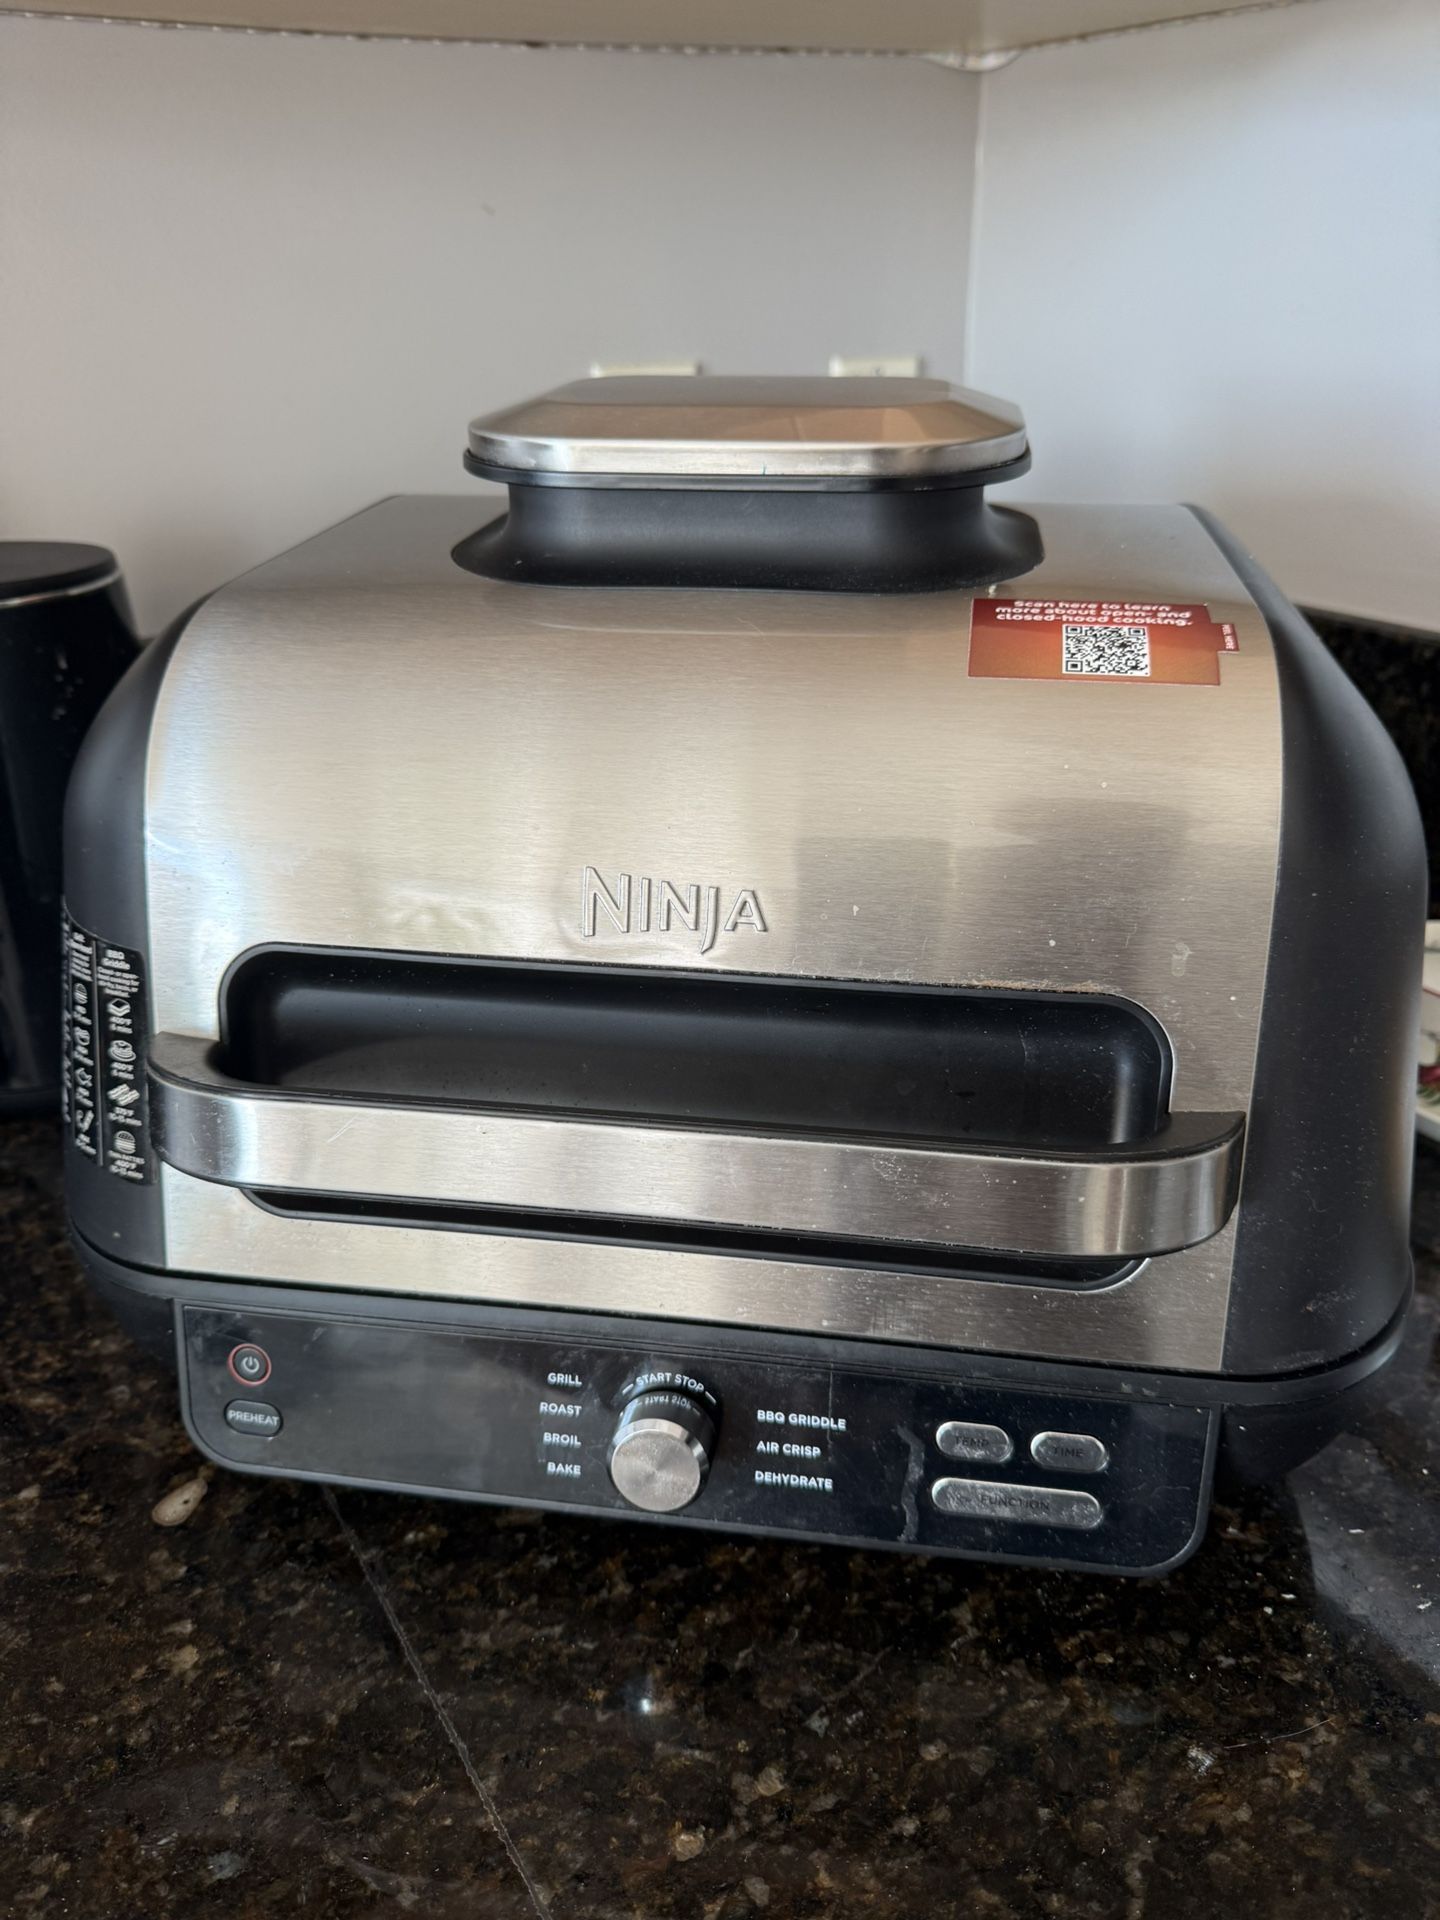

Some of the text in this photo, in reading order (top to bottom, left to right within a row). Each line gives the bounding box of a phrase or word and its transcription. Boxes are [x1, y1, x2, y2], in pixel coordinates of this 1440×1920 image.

[995, 606, 1192, 619] more about open- and
[1014, 600, 1171, 612] Scan here to learn
[996, 612, 1193, 627] closed-hood cooking.
[581, 866, 768, 954] NINJA
[547, 1372, 582, 1386] GRILL
[635, 1372, 705, 1393] START STOP
[539, 1402, 582, 1416] ROAST
[228, 1409, 280, 1427] PREHEAT
[757, 1409, 847, 1431] BBQ GRIDDLE
[543, 1432, 582, 1446] BROIL
[954, 1435, 990, 1448] TEMP
[756, 1440, 822, 1459] AIR CRISP
[1052, 1445, 1085, 1458] TIME
[547, 1462, 582, 1476] BAKE
[754, 1469, 833, 1492] DEHYDRATE
[980, 1494, 1051, 1511] FUNCTION
